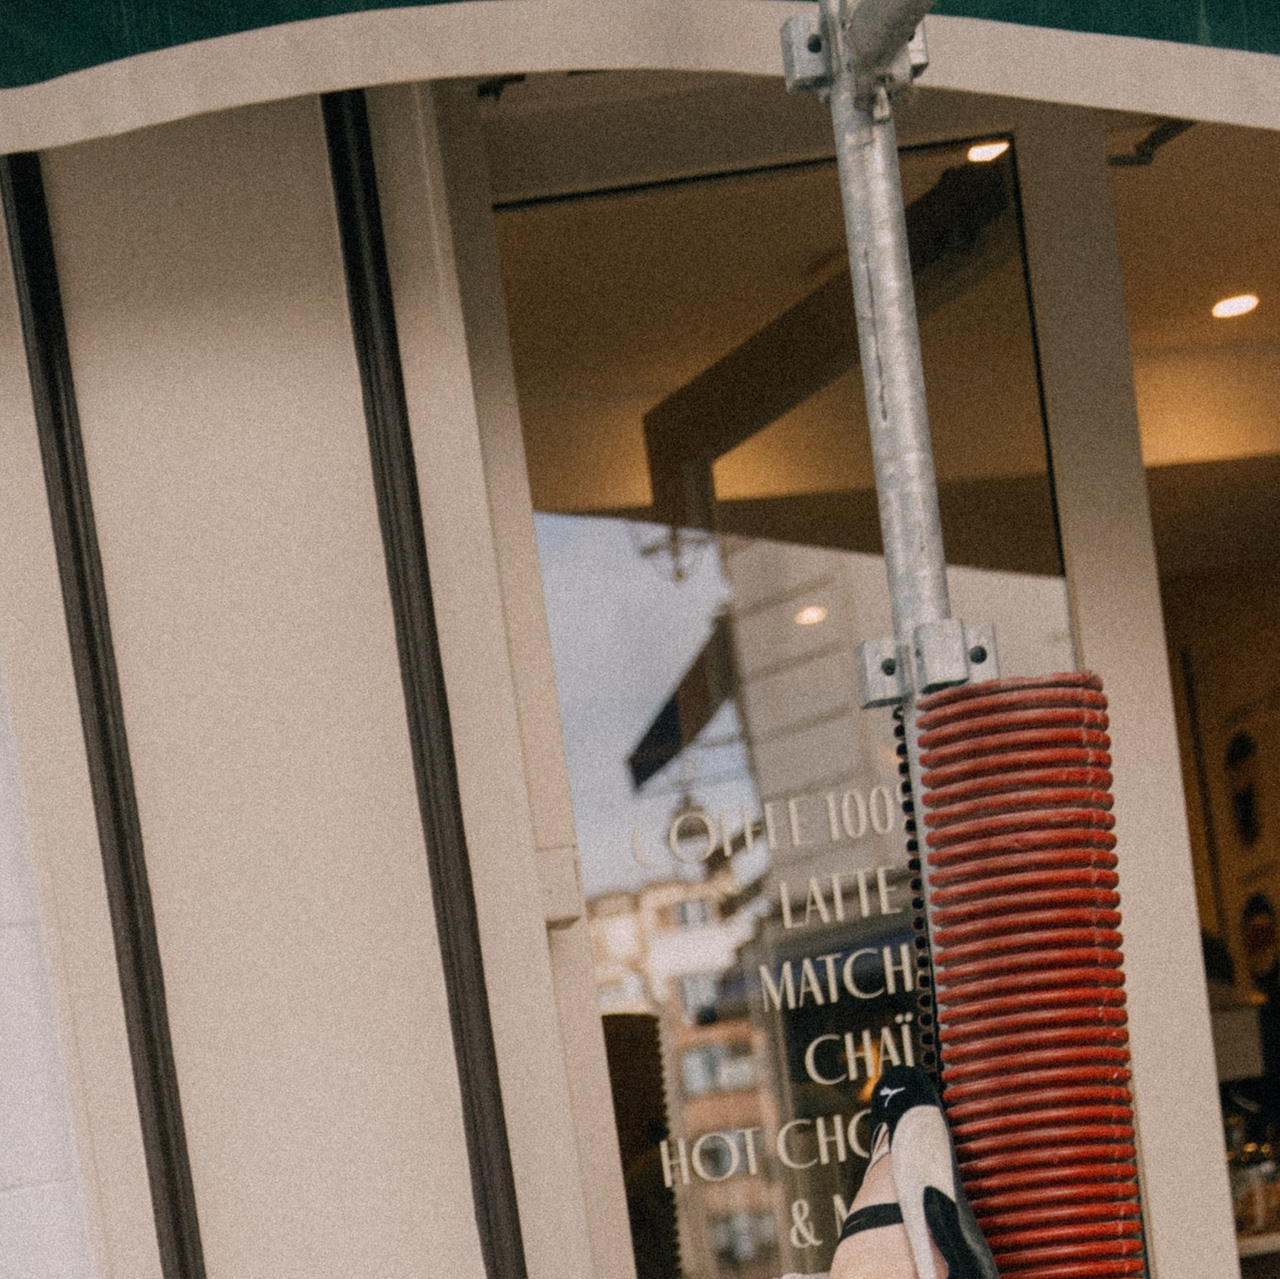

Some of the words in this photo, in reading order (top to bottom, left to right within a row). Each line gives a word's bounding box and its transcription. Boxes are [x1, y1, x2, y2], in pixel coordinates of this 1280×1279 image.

[825, 782, 902, 842] 100
[779, 866, 904, 929] LATTE
[804, 1012, 916, 1086] CHAÏ
[659, 1126, 761, 1188] HOT
[789, 1199, 823, 1249] &
